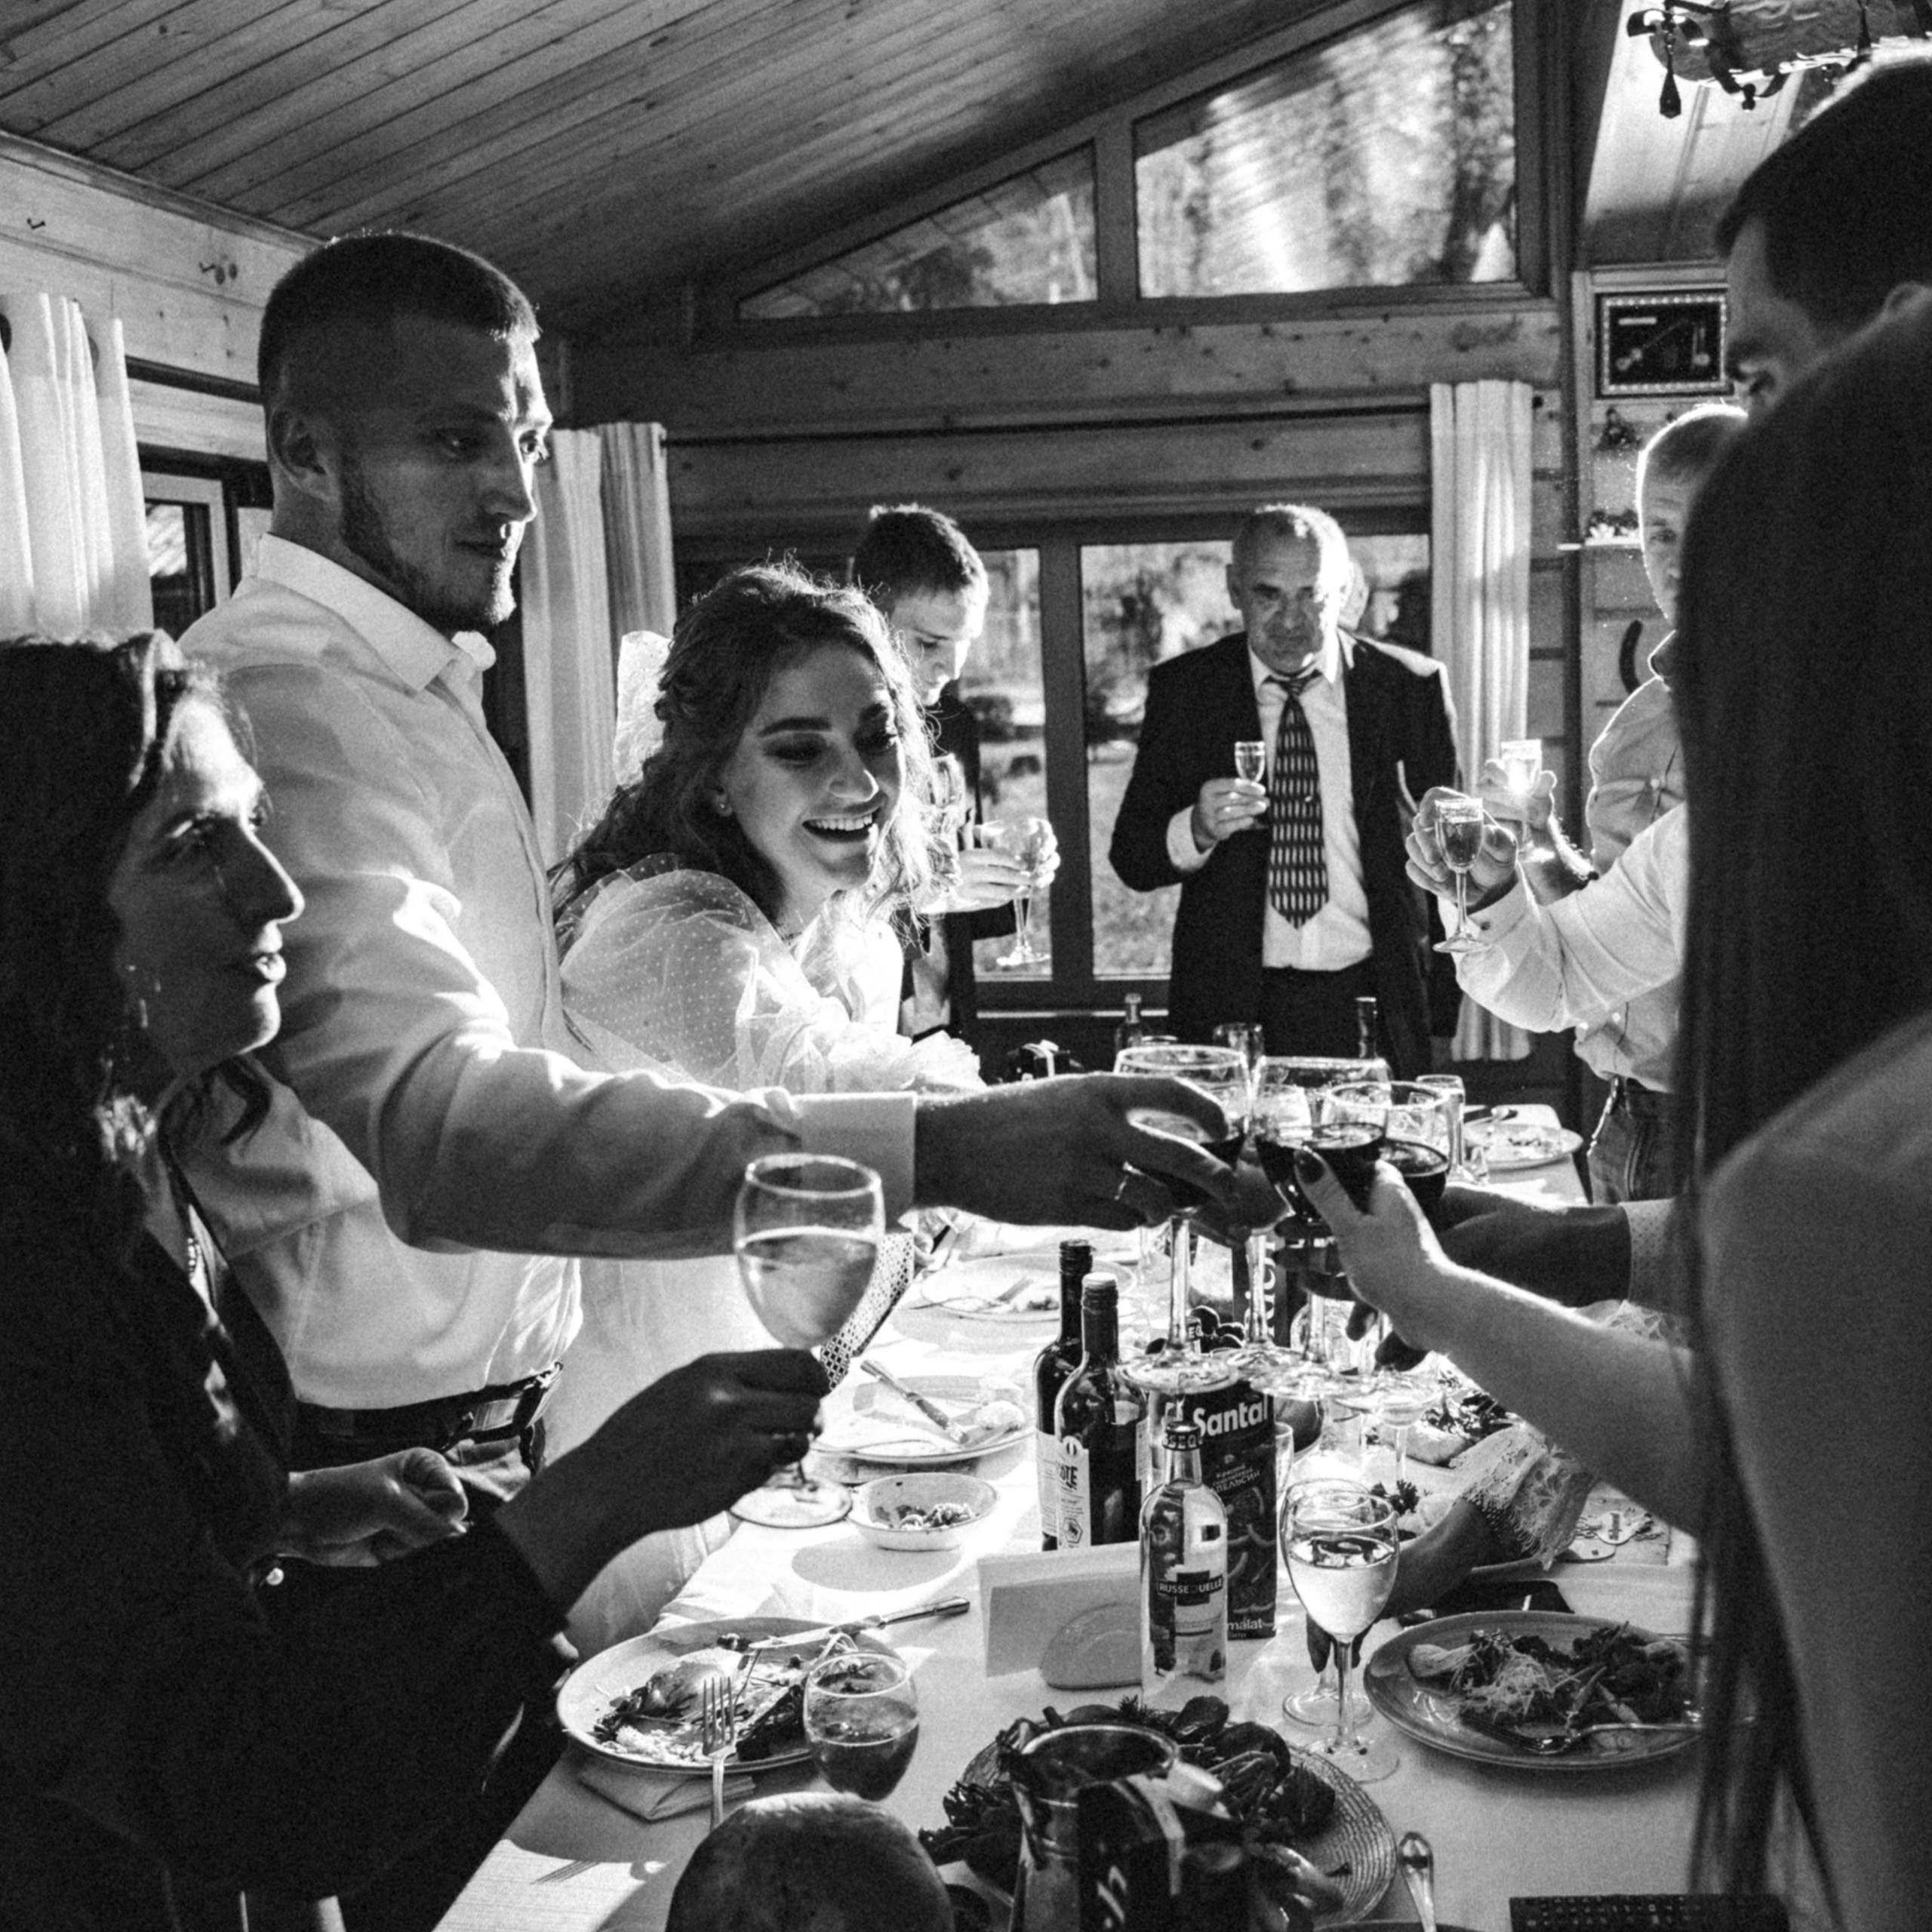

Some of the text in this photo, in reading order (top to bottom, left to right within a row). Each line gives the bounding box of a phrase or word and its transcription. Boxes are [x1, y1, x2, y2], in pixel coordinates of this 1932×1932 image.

[1193, 1393, 1268, 1437] Santal
[1215, 1470, 1261, 1494] ПЕЛЬСИН
[1227, 1617, 1263, 1631] malat
